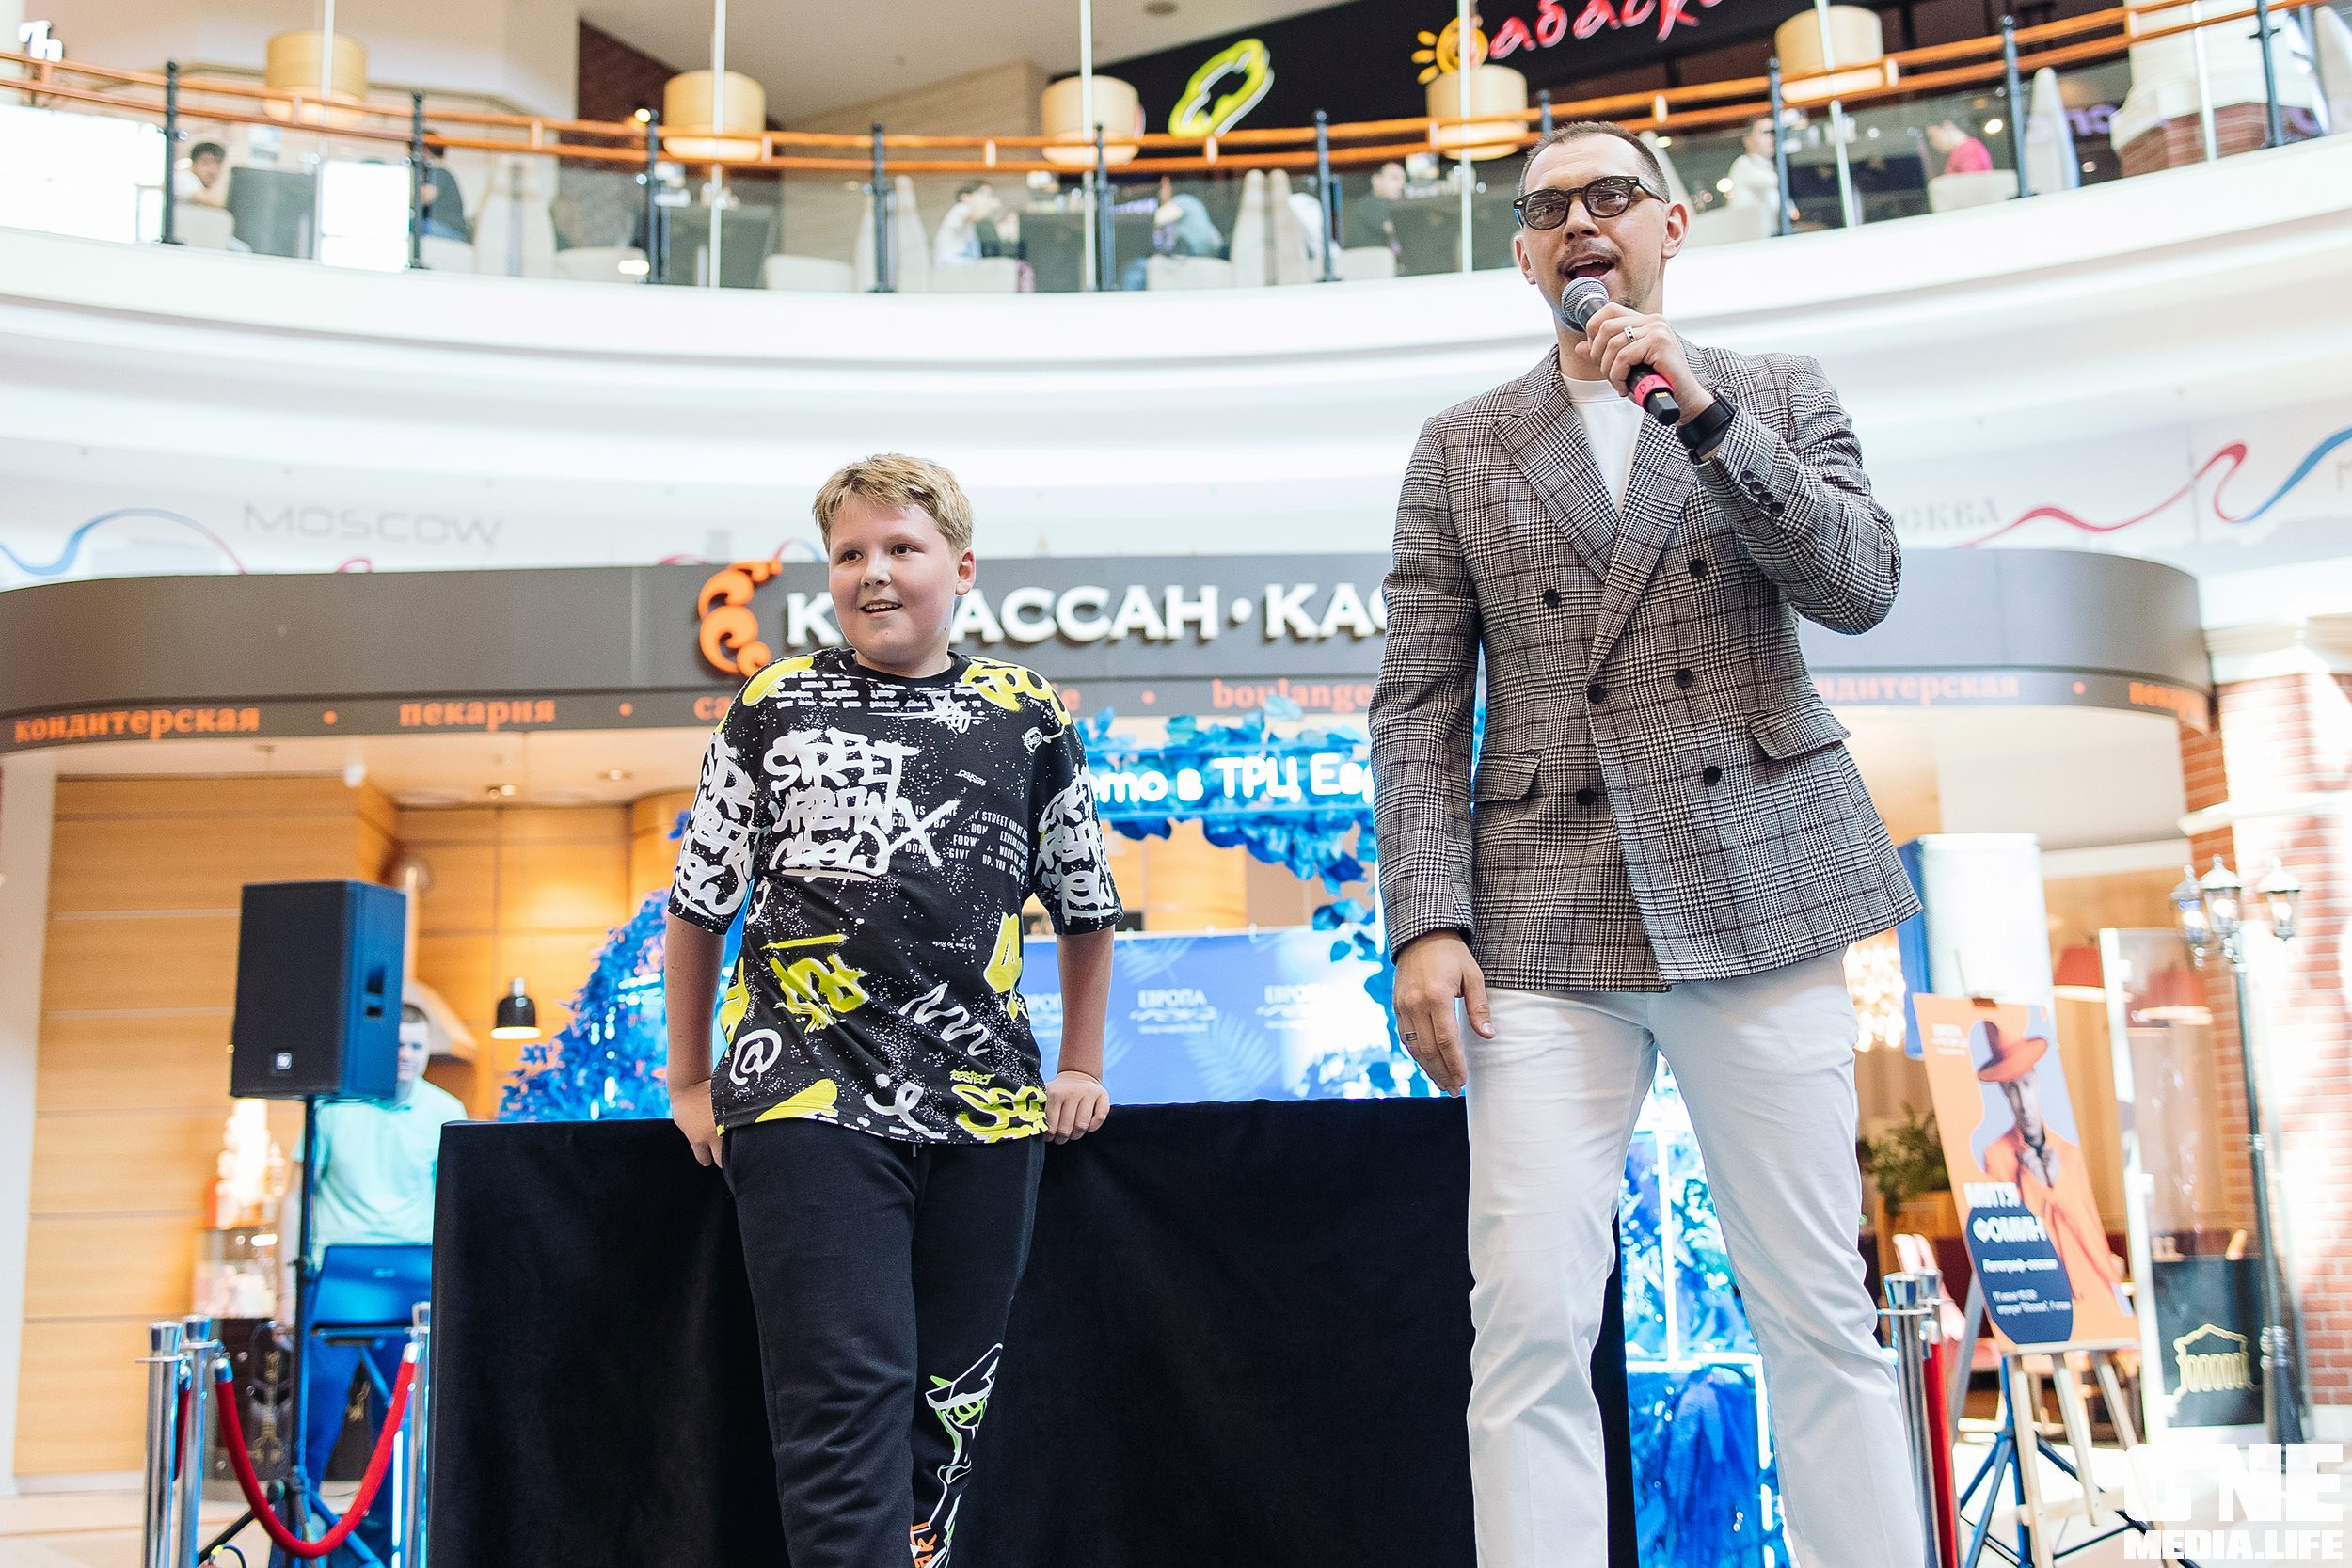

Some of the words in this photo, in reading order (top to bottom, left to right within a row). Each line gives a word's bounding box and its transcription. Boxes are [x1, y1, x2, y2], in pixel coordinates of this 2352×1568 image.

[243, 502, 503, 546] MOSCOW
[1899, 495, 2001, 534] СКВА
[787, 584, 1219, 647] КАССАН
[1212, 681, 1374, 714] boulange
[1815, 675, 2018, 705] ндитерская
[14, 707, 260, 741] кондитерская
[1176, 768, 1204, 801] в
[1212, 755, 1302, 804] ТРЦ
[981, 811, 1009, 828] STREET
